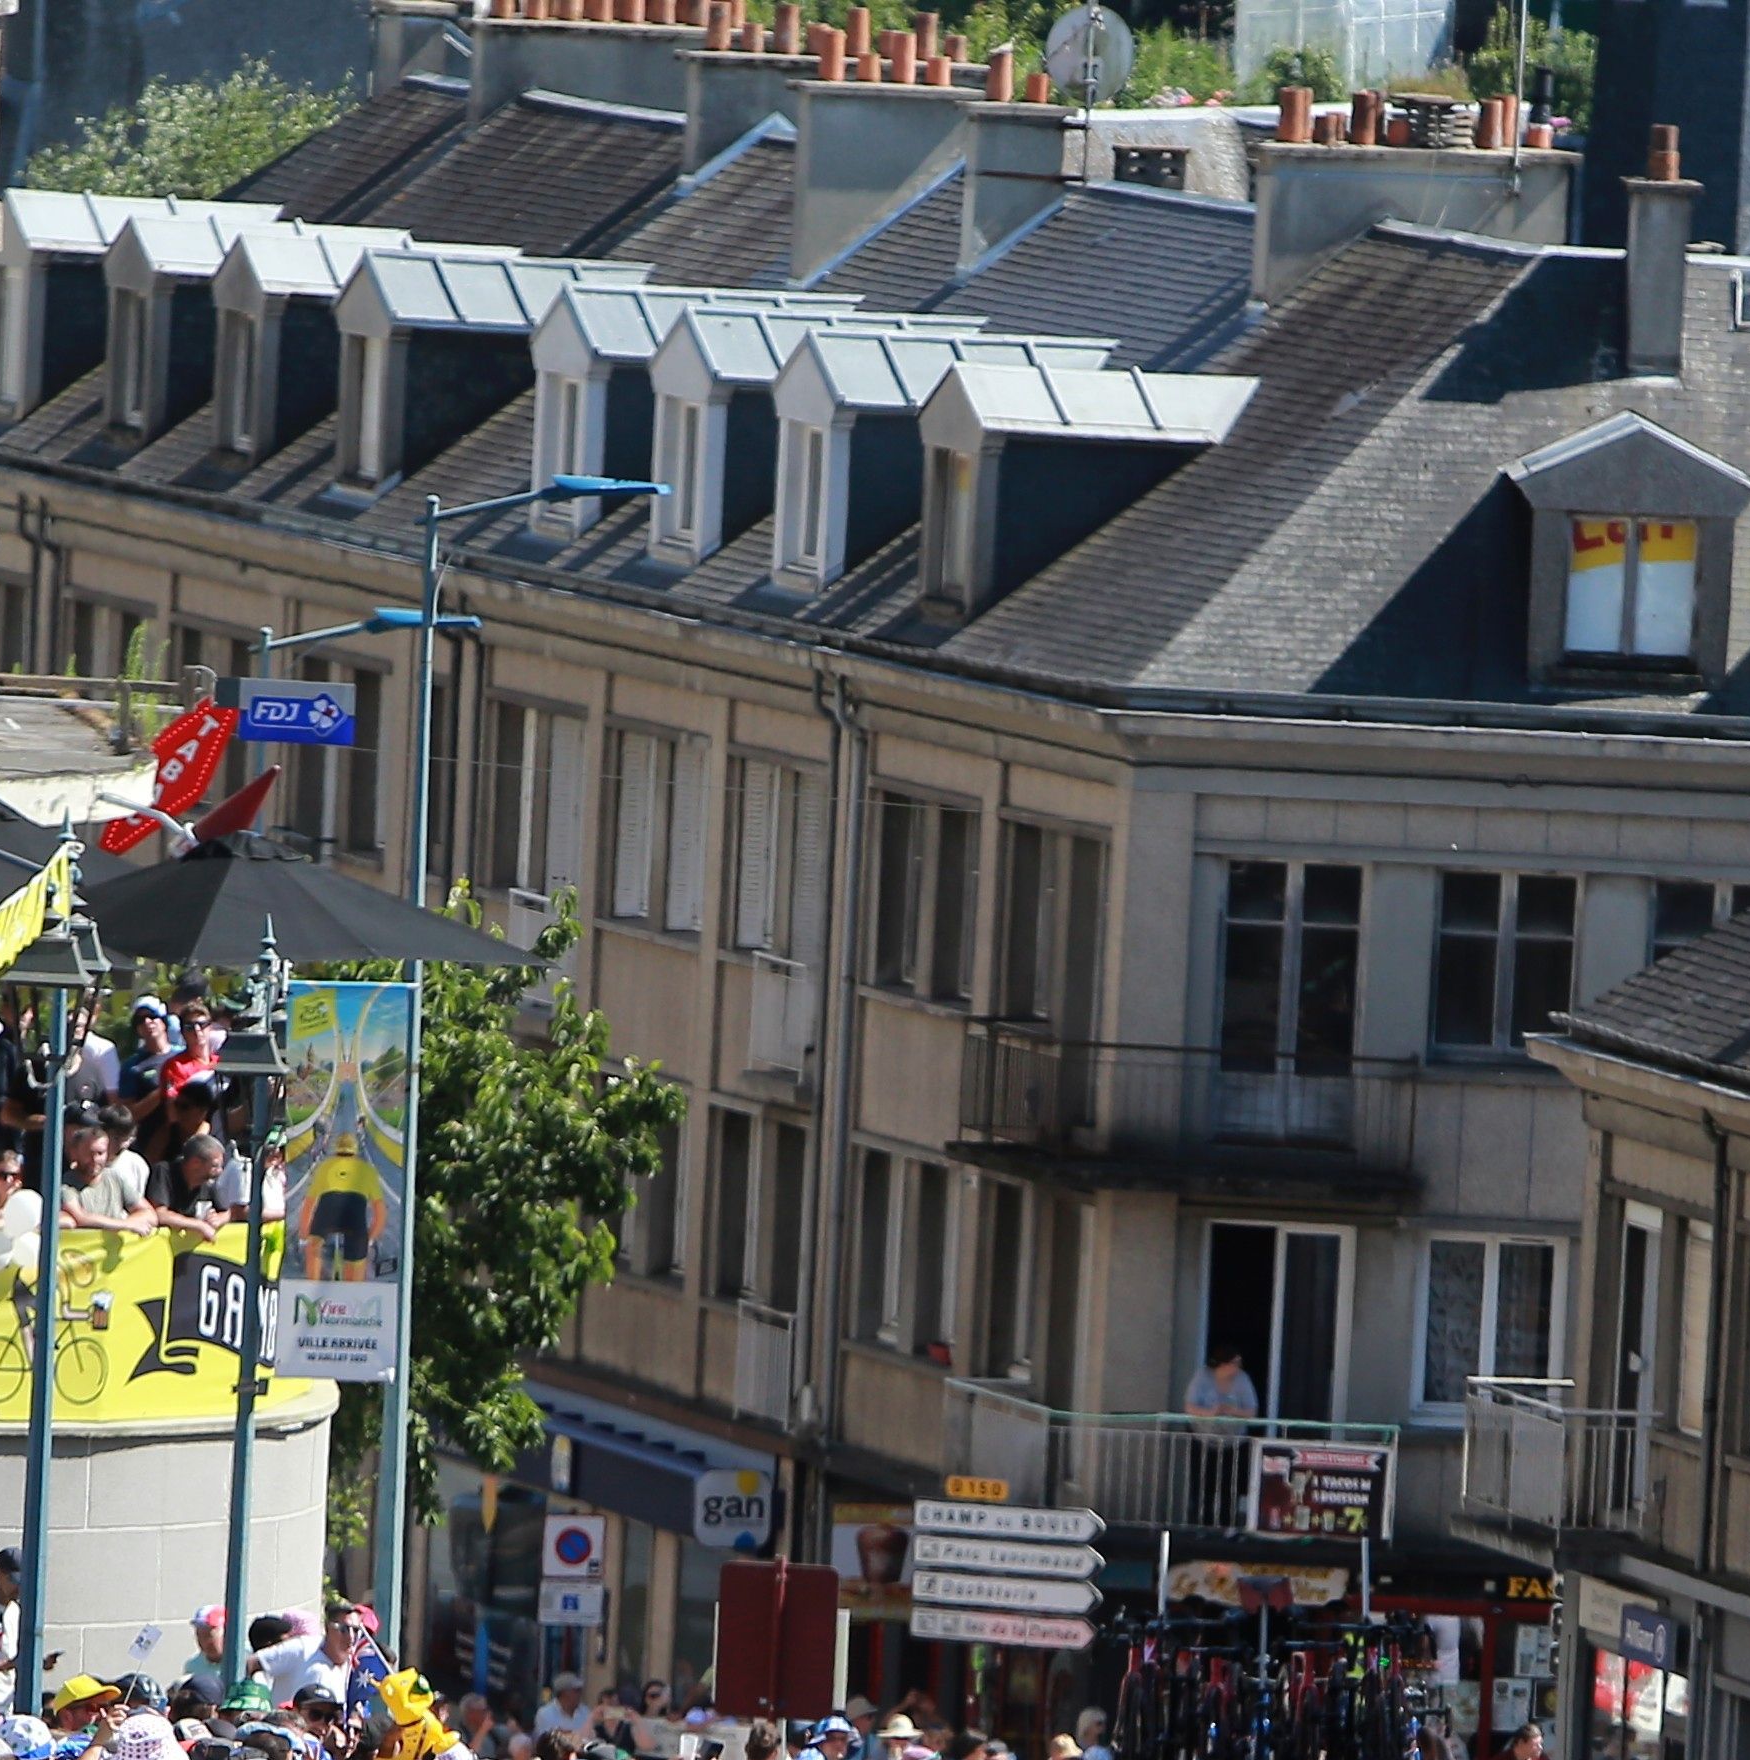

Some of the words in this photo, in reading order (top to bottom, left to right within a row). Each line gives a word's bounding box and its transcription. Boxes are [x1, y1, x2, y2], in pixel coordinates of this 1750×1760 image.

[254, 701, 301, 722] FDJ
[320, 1300, 348, 1315] Vire
[298, 1335, 329, 1350] VILLE
[332, 1335, 378, 1351] ARRIVÉE
[703, 1495, 765, 1528] gan
[919, 1505, 989, 1524] CHAMP
